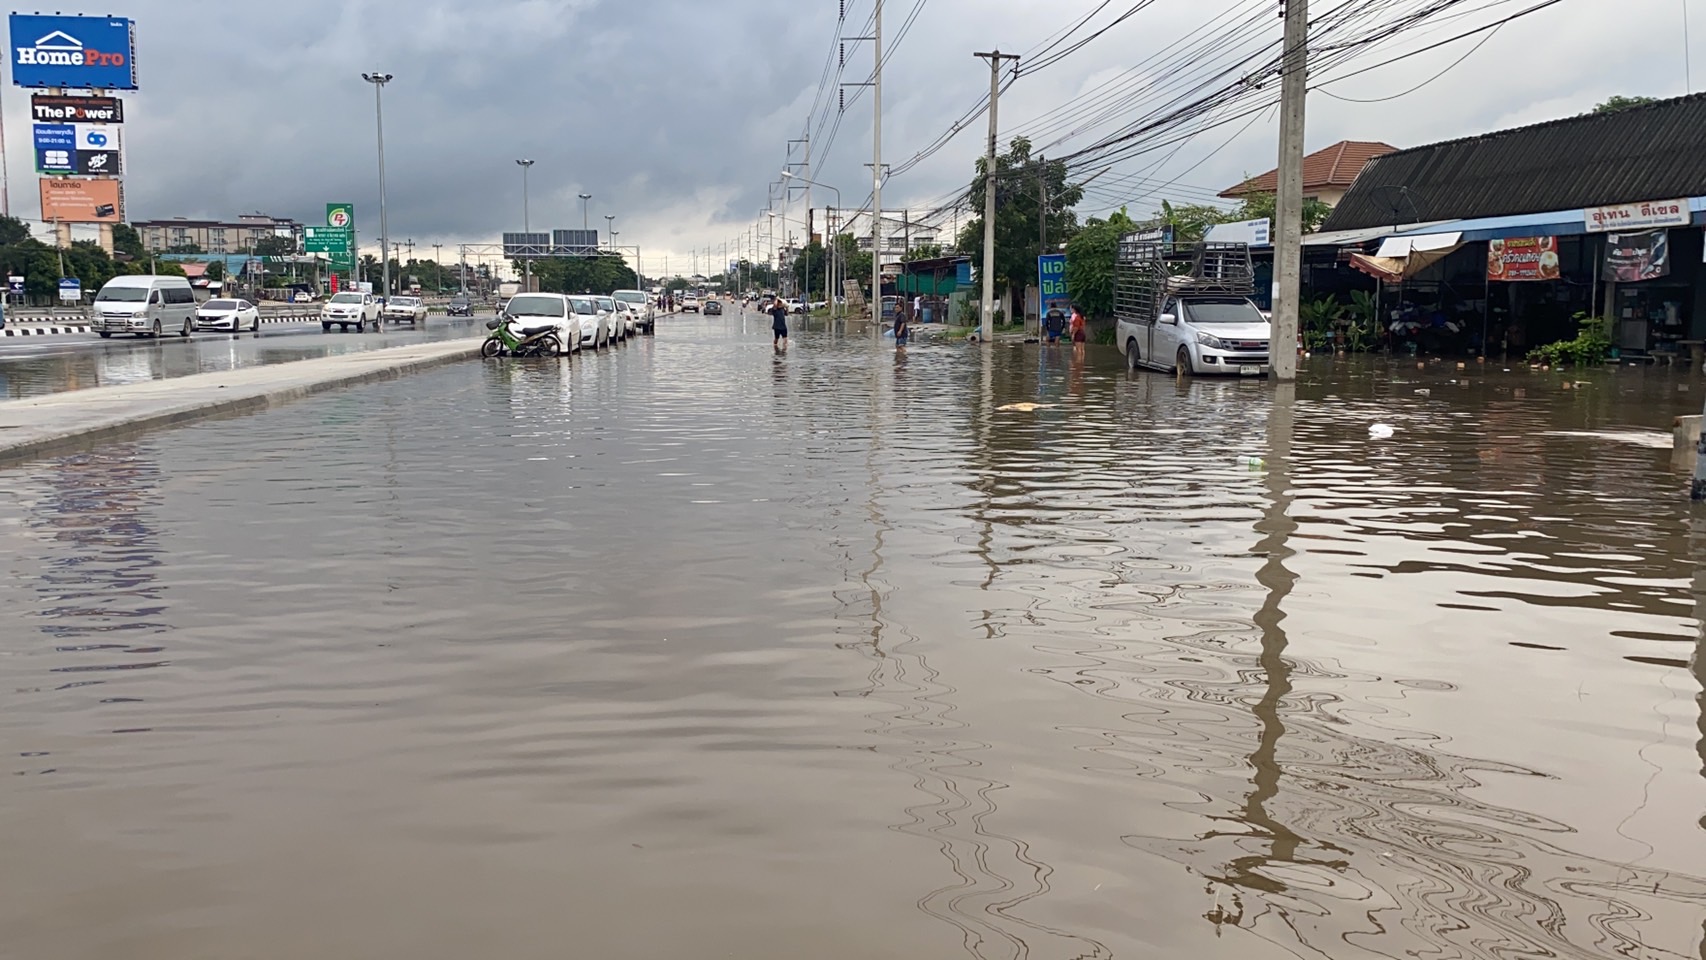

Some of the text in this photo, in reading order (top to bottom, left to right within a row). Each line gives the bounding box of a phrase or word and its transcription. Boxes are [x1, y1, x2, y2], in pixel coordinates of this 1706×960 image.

[17, 47, 125, 67] HomePro
[34, 105, 114, 120] The Power
[334, 213, 346, 226] PT
[1592, 209, 1631, 225] อุเทน
